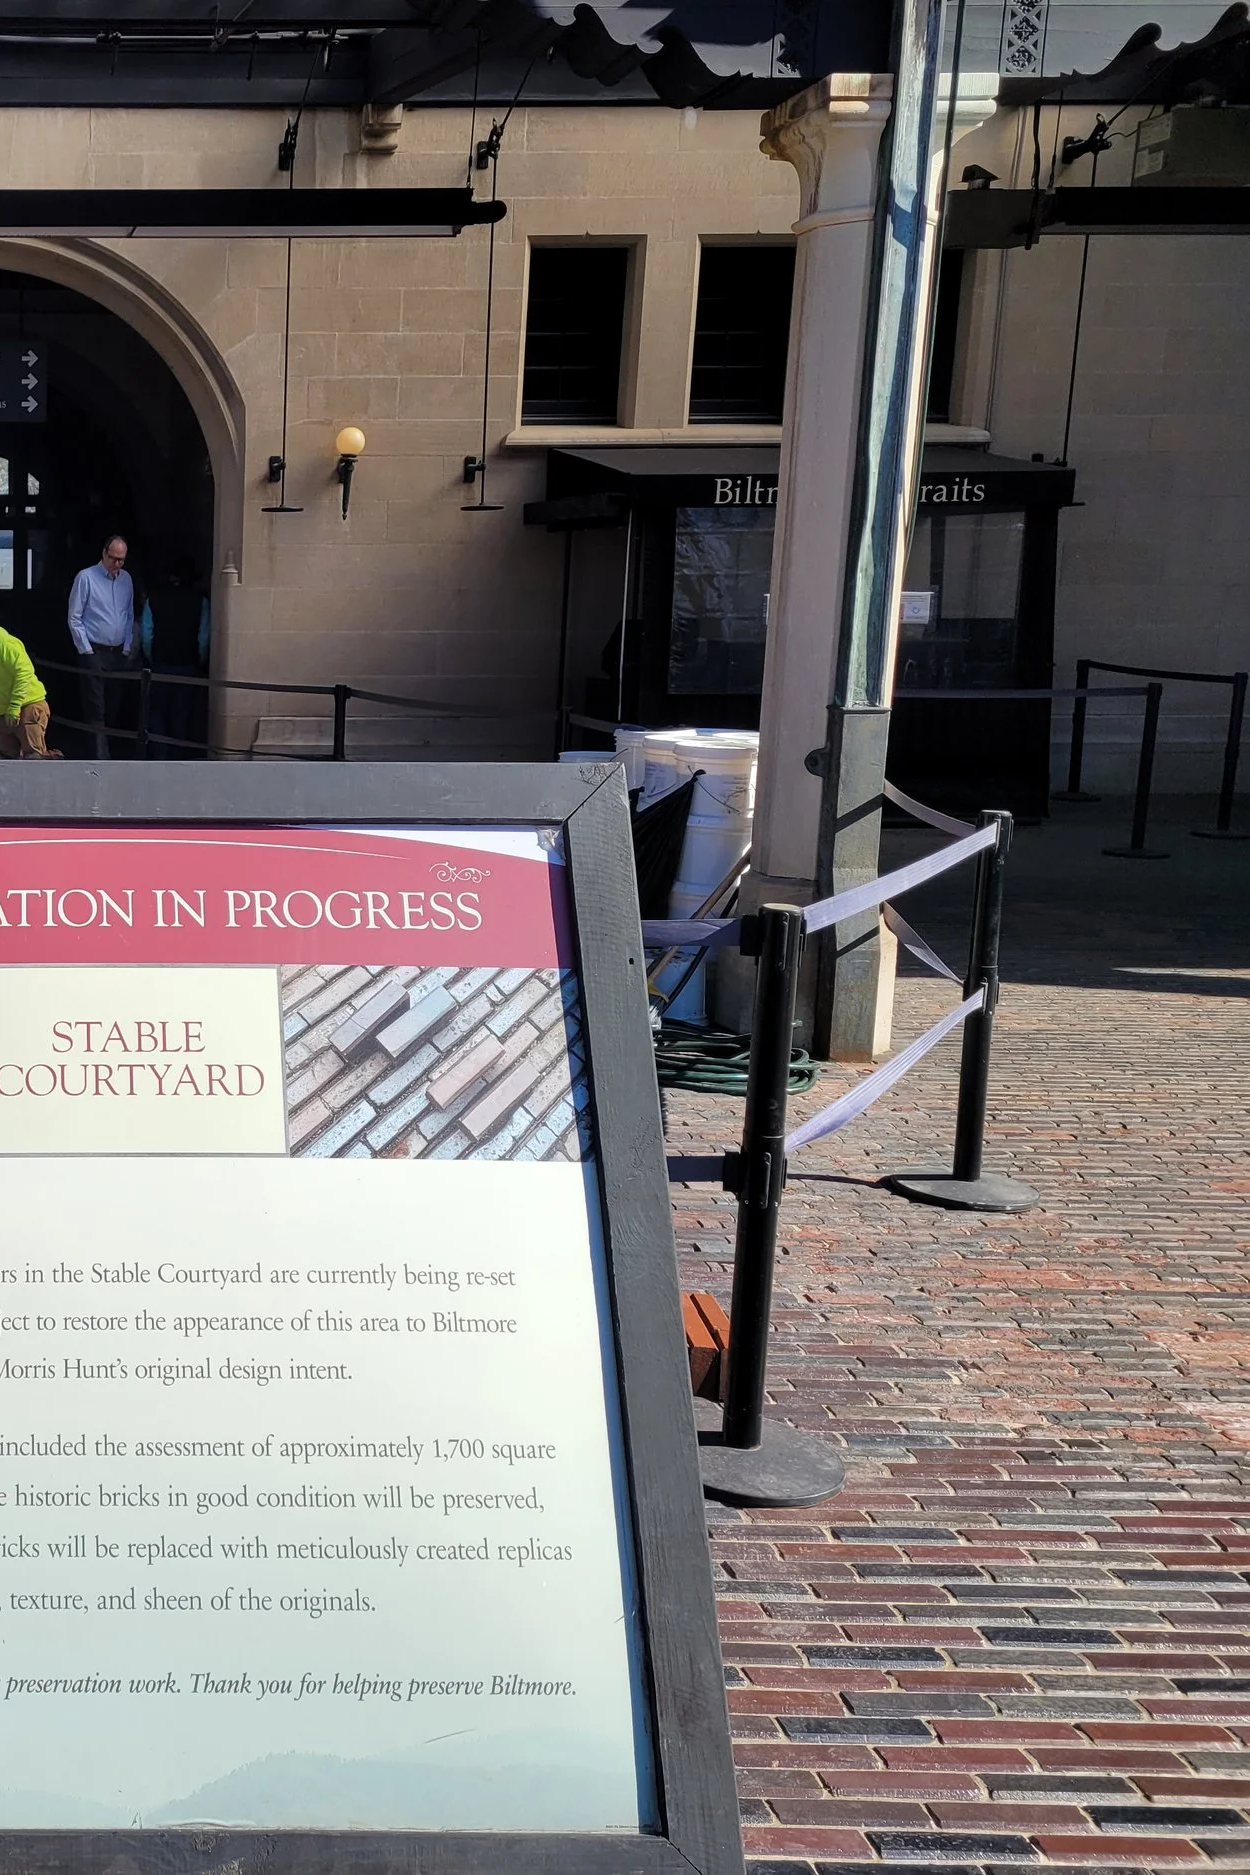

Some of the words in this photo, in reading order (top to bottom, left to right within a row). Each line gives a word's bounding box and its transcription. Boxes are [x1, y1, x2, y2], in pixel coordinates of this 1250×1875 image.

[920, 477, 986, 503] raits
[154, 889, 206, 929] IN
[225, 889, 483, 931] PROGRESS
[52, 1021, 206, 1053] STABLE
[25, 1263, 44, 1283] in
[52, 1262, 83, 1283] the
[91, 1262, 150, 1283] Stable
[158, 1262, 262, 1290] Courtyard
[270, 1270, 300, 1283] are
[307, 1263, 396, 1291] currently
[404, 1264, 460, 1292] being
[466, 1271, 516, 1286] re-set
[36, 1315, 56, 1330] to
[63, 1315, 127, 1330] restore
[135, 1309, 166, 1330] the
[174, 1317, 283, 1337] appearance
[291, 1309, 312, 1331] of
[317, 1310, 352, 1331] this
[360, 1318, 400, 1331] area
[406, 1317, 425, 1332] to
[432, 1311, 517, 1333] Biltmore
[63, 1358, 127, 1378] Hunt’s
[135, 1357, 212, 1386] original
[219, 1357, 282, 1386] design
[290, 1358, 352, 1379] intent.
[0, 1434, 86, 1456] included
[95, 1434, 127, 1456] the
[135, 1441, 245, 1456] assessment
[252, 1434, 274, 1457] of
[280, 1435, 424, 1465] approximately
[433, 1439, 484, 1462] 1,700
[492, 1444, 556, 1465] square
[15, 1484, 91, 1506] historic
[99, 1484, 159, 1506] bricks
[168, 1485, 188, 1506] in
[197, 1484, 248, 1514] good
[257, 1484, 356, 1507] condition
[363, 1485, 402, 1508] will
[410, 1486, 435, 1508] be
[443, 1487, 544, 1516] preserved,
[47, 1535, 86, 1558] will
[95, 1535, 119, 1558] be
[128, 1535, 213, 1565] replaced
[220, 1536, 268, 1558] with
[277, 1536, 409, 1567] meticulously
[416, 1537, 490, 1560] created
[498, 1538, 572, 1567] replicas
[10, 1593, 88, 1614] texture,
[97, 1587, 136, 1610] and
[144, 1587, 202, 1610] sheen
[211, 1587, 234, 1610] of
[239, 1587, 272, 1610] the
[280, 1588, 375, 1619] originals.
[4, 1672, 121, 1700] preservation
[129, 1672, 180, 1693] work.
[190, 1672, 252, 1693] Thank
[256, 1679, 293, 1702] you
[296, 1672, 326, 1701] for
[332, 1673, 403, 1701] helping
[406, 1678, 483, 1701] preserve
[490, 1674, 575, 1695] Biltmore.
